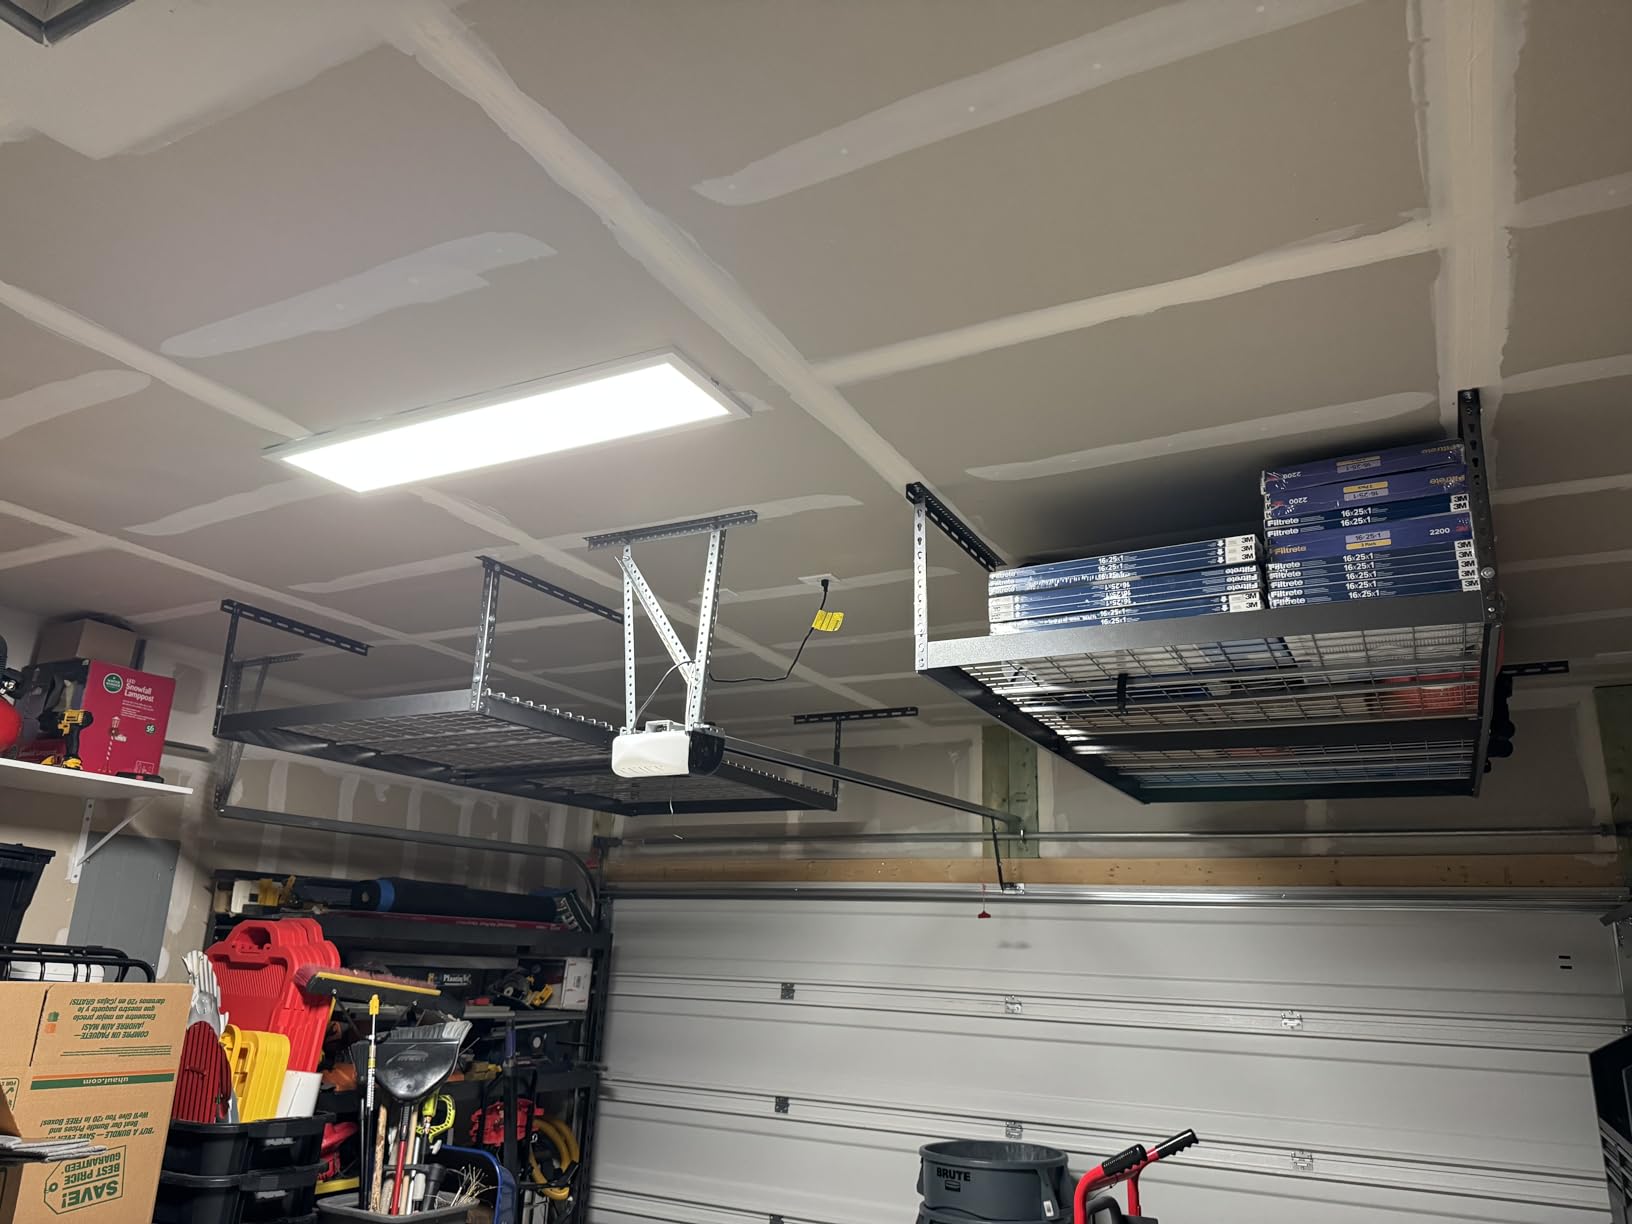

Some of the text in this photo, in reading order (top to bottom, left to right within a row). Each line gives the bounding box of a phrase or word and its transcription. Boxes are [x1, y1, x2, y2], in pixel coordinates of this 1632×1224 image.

[1288, 496, 1308, 504] 2200
[1266, 518, 1299, 526] Filtrete
[1341, 507, 1372, 517] 16x25x1
[1266, 528, 1299, 538] Filtrete
[1340, 516, 1370, 526] 16x25x1
[1429, 528, 1450, 536] 2200
[1098, 555, 1124, 564] 16x25x1
[1342, 552, 1374, 562] 16x25x1
[1344, 562, 1375, 571] 16x25x1
[1270, 580, 1304, 588] Filtrete
[1346, 570, 1377, 580] 16x25x1
[1270, 590, 1303, 598] Filtrete
[1345, 580, 1377, 590] 16x25x1
[1348, 590, 1380, 599] 16x25x1
[126, 683, 152, 695] Snowfall
[124, 690, 154, 702] Lamppost
[40, 1118, 64, 1127] Boxes!
[66, 1116, 83, 1125] FREE
[48, 1127, 62, 1135] and
[64, 1125, 85, 1133] Prices
[64, 1163, 120, 1185] BEST PRICE
[936, 1167, 971, 1181] BRUTE
[61, 1180, 119, 1208] SAVE!
